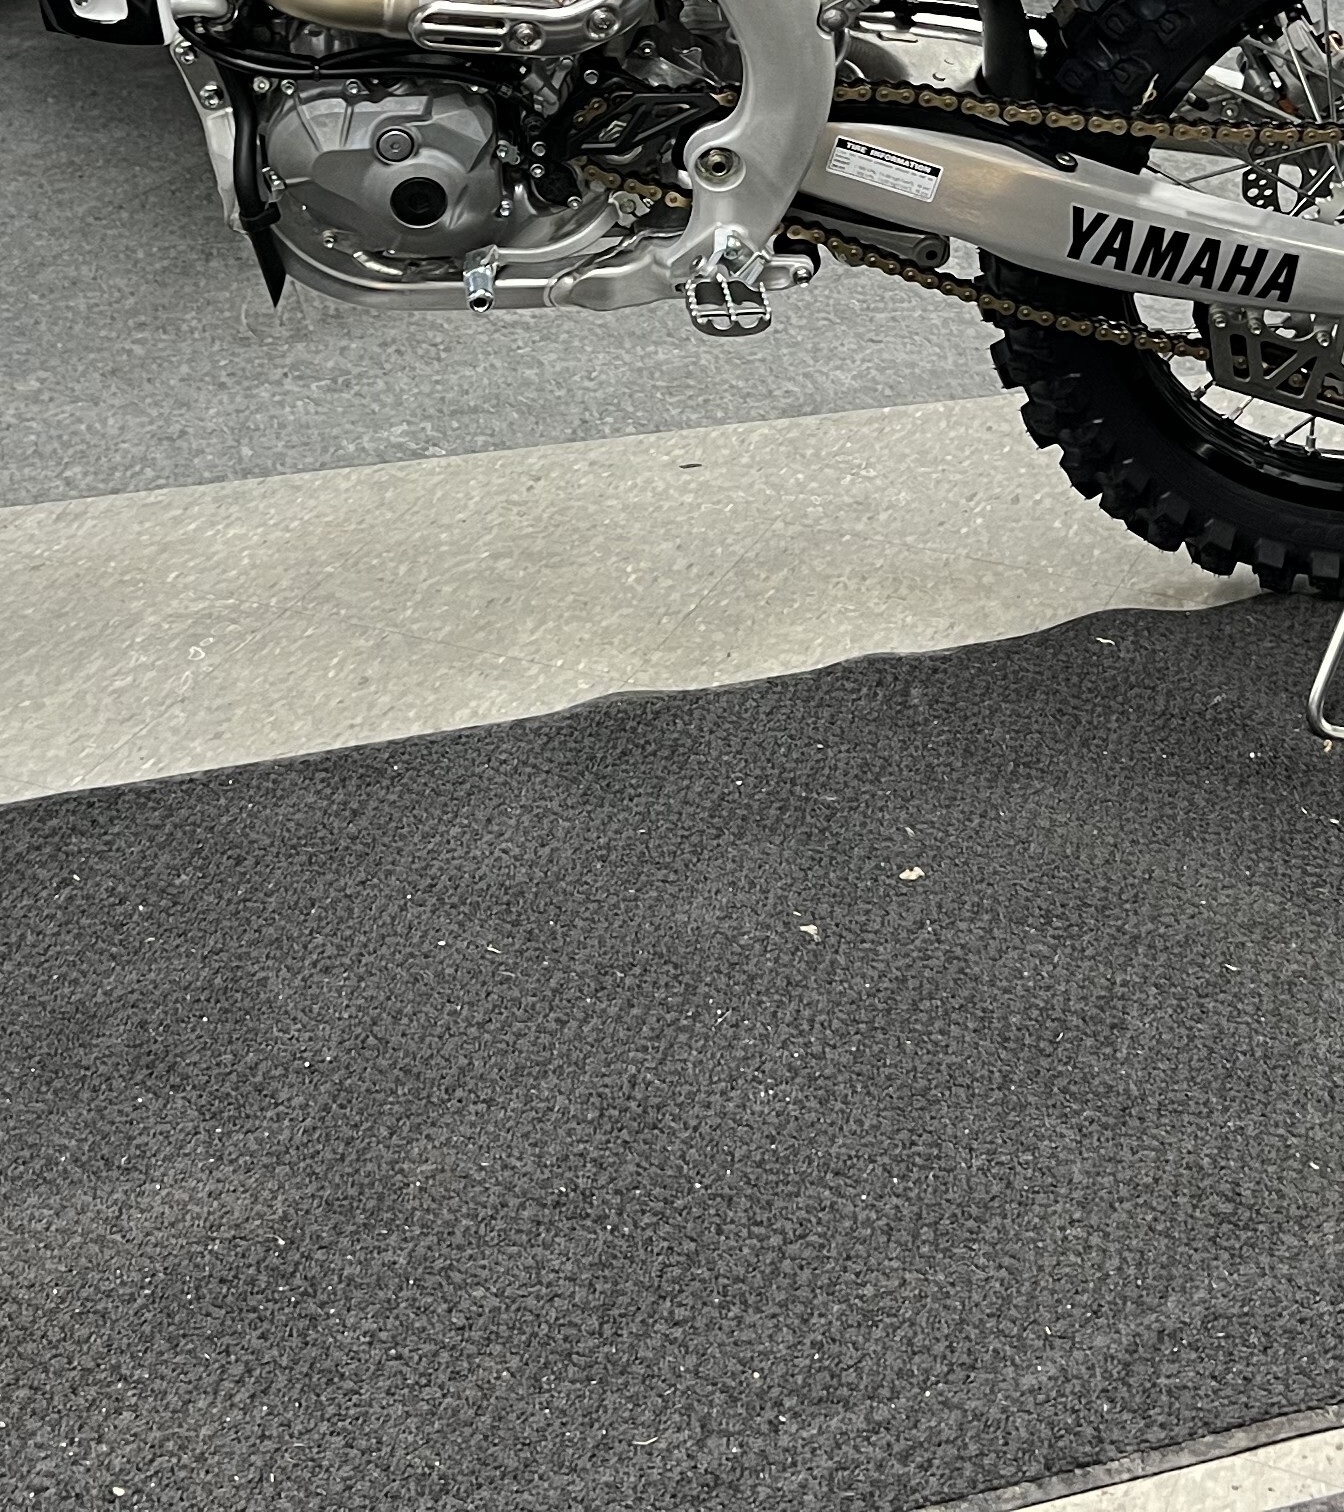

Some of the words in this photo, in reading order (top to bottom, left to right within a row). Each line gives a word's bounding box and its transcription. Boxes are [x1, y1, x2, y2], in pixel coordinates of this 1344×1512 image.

[846, 141, 868, 154] TIRE
[869, 149, 932, 174] INFORMATION
[1067, 203, 1301, 304] YAMAHA
